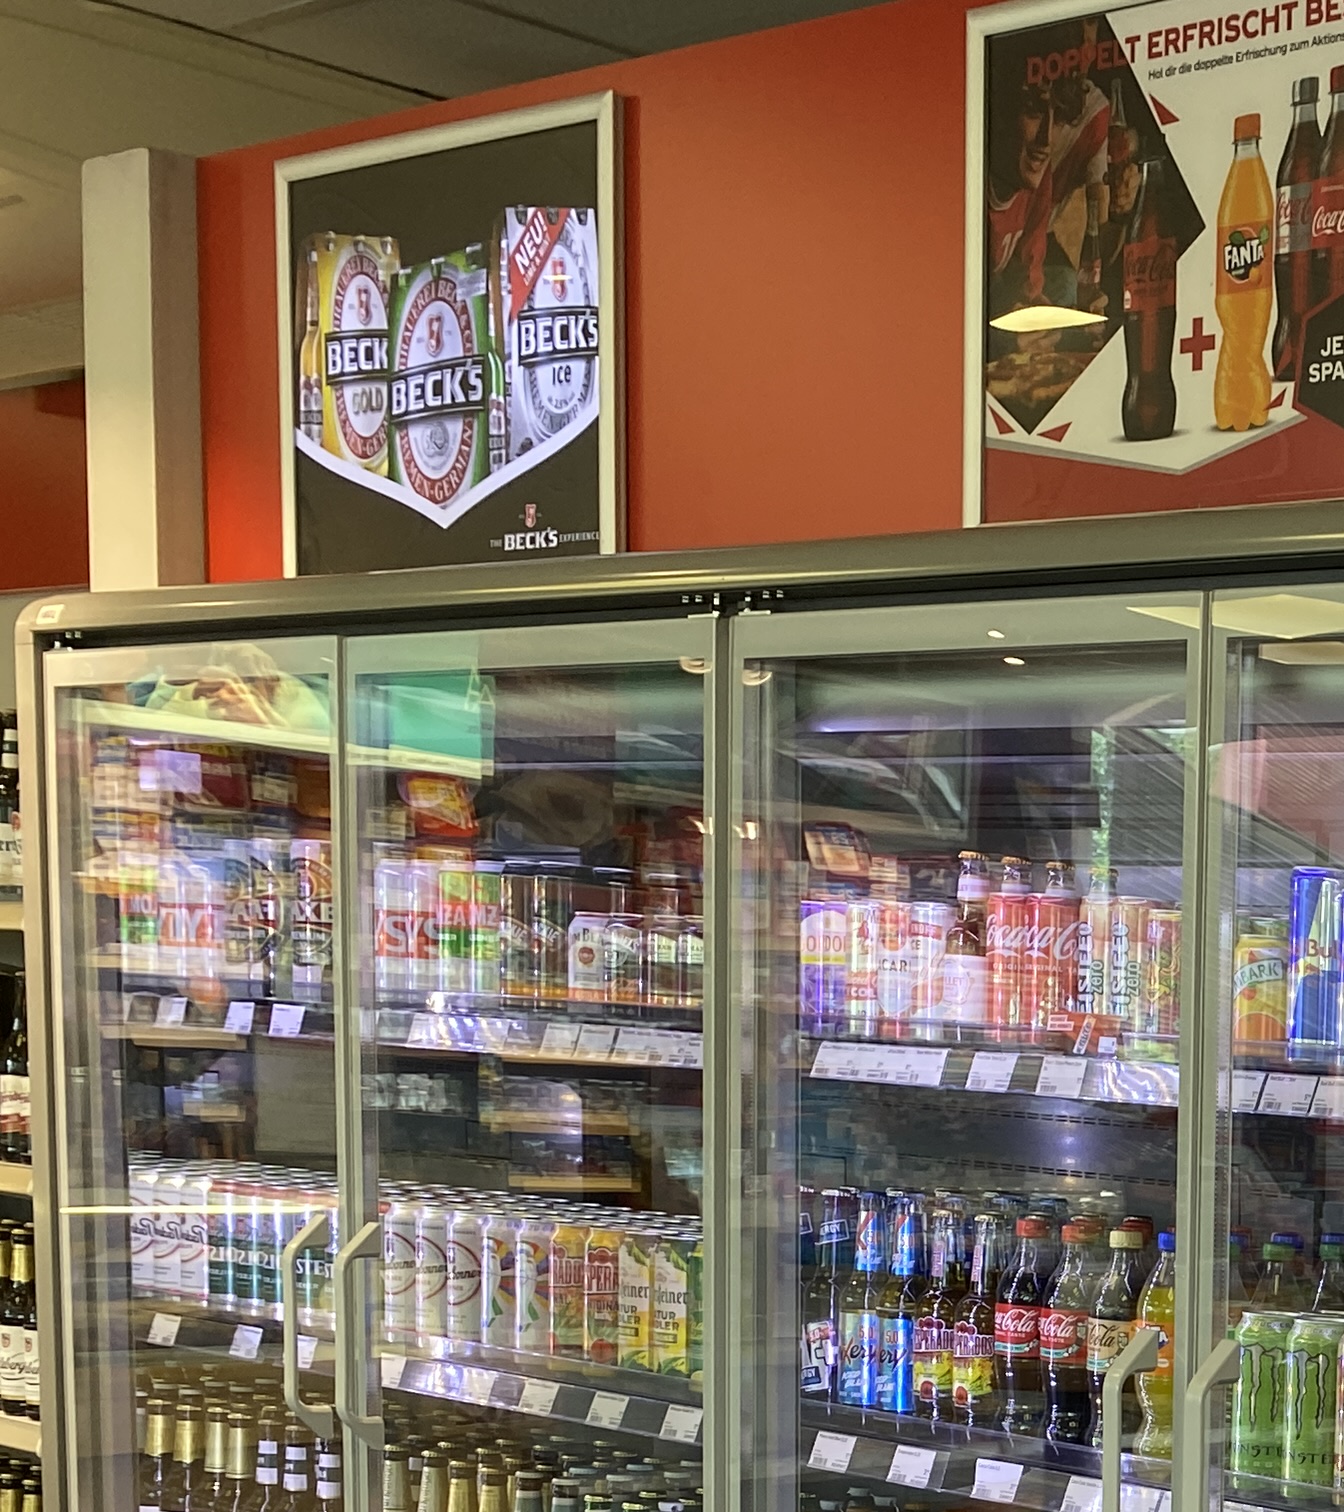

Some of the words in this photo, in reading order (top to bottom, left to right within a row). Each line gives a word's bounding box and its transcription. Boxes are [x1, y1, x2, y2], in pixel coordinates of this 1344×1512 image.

[1147, 15, 1297, 59] ERFRISCHT
[1148, 69, 1164, 80] Hol
[1166, 67, 1177, 78] dir
[1179, 64, 1192, 76] die
[1194, 58, 1234, 74] doppelte
[1235, 49, 1287, 68] Erfrischung
[514, 213, 548, 273] NEU!
[1224, 237, 1264, 269] FANTA
[520, 316, 598, 356] BECK'S
[392, 360, 483, 415] BECK'S
[504, 528, 558, 551] BECK'S
